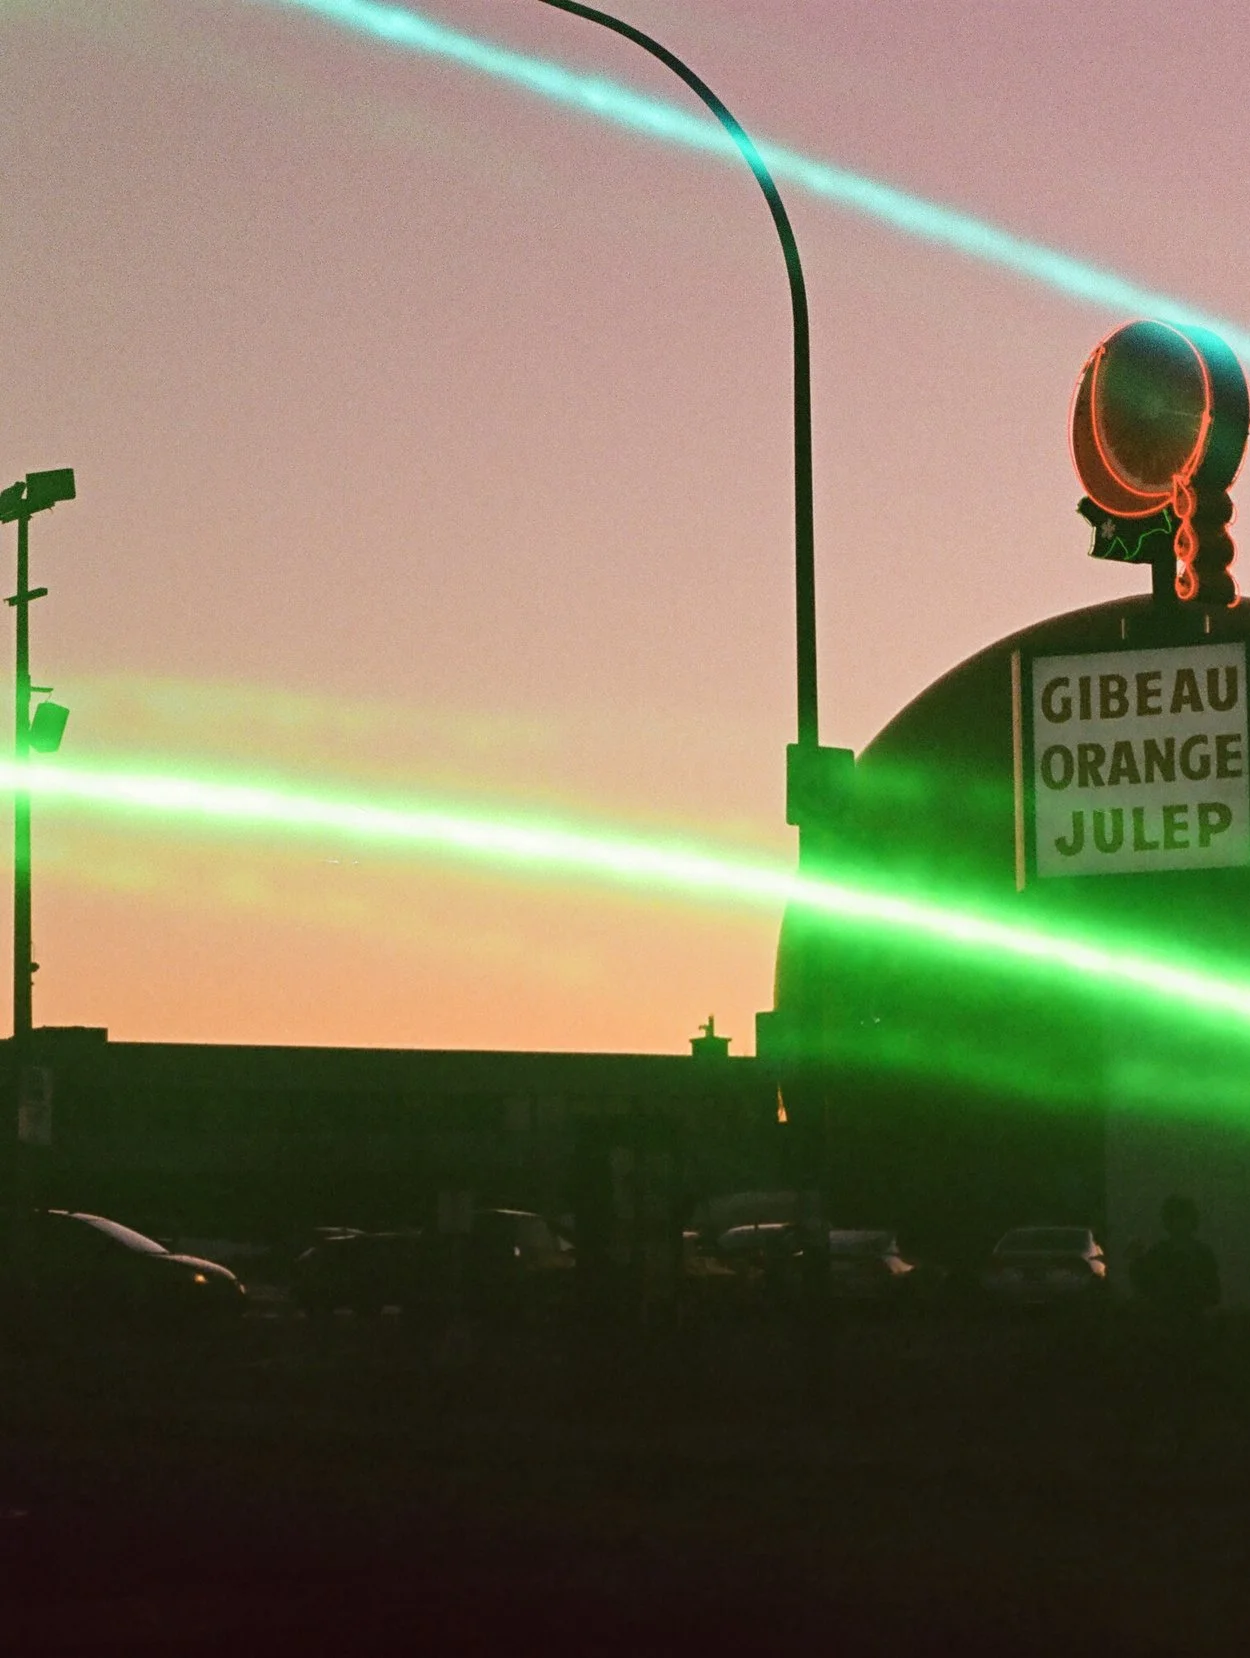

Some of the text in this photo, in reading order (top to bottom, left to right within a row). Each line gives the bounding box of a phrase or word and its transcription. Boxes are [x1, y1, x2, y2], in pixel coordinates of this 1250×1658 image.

[1041, 666, 1238, 724] GIBEAU
[1041, 734, 1243, 790] ORANGE
[1054, 802, 1232, 856] JULEP
